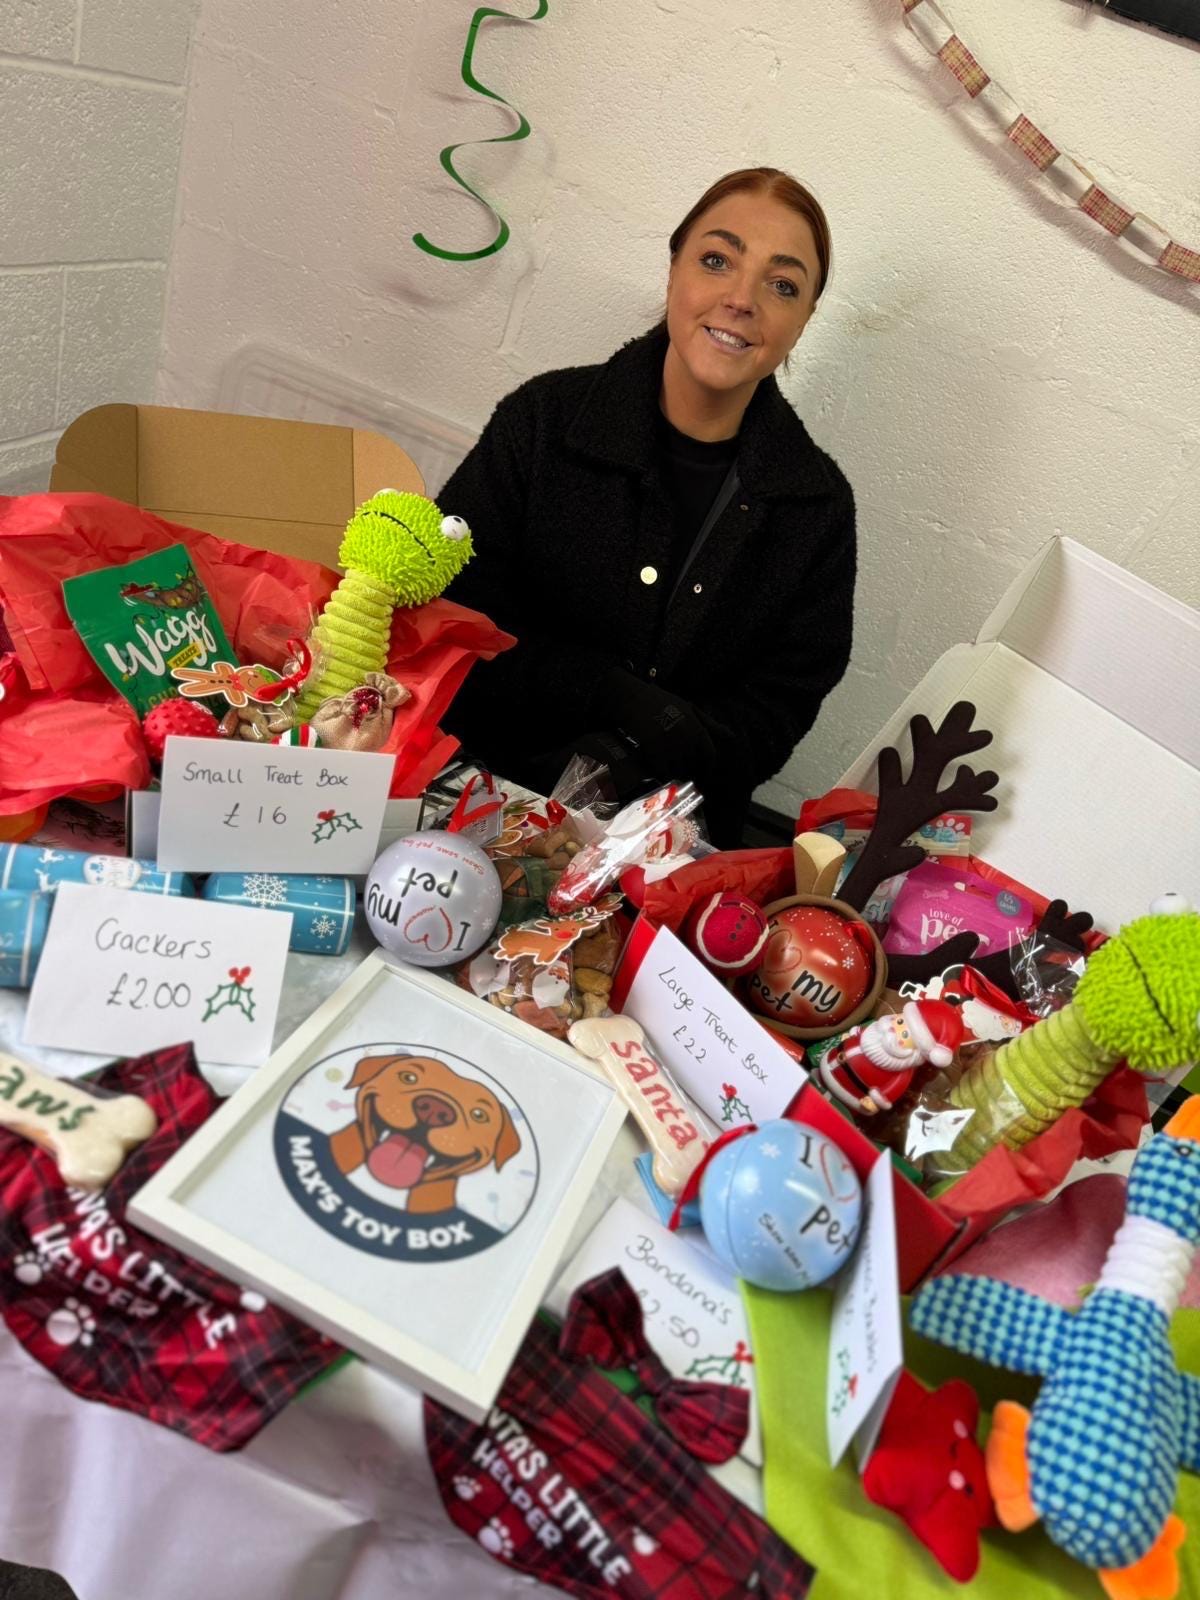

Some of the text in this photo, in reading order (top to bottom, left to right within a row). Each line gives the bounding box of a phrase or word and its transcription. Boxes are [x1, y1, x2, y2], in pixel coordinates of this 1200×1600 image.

[104, 610, 217, 677] Wagg
[182, 761, 348, 787] Small Treat Box
[398, 867, 458, 899] pet
[367, 883, 402, 927] my
[95, 917, 212, 960] Crackers
[453, 921, 471, 951] I
[106, 972, 191, 1010] £2.00
[752, 973, 793, 1012] pet
[791, 970, 842, 1013] my
[658, 966, 769, 1085] Large Treat Box
[799, 1133, 813, 1169] I
[288, 1135, 474, 1249] MAX'S TOY BOX
[118, 1251, 237, 1351] LITTLE
[625, 1234, 733, 1326] Bandana's
[472, 1438, 563, 1549] HELPER
[539, 1473, 633, 1587] LITTLE
